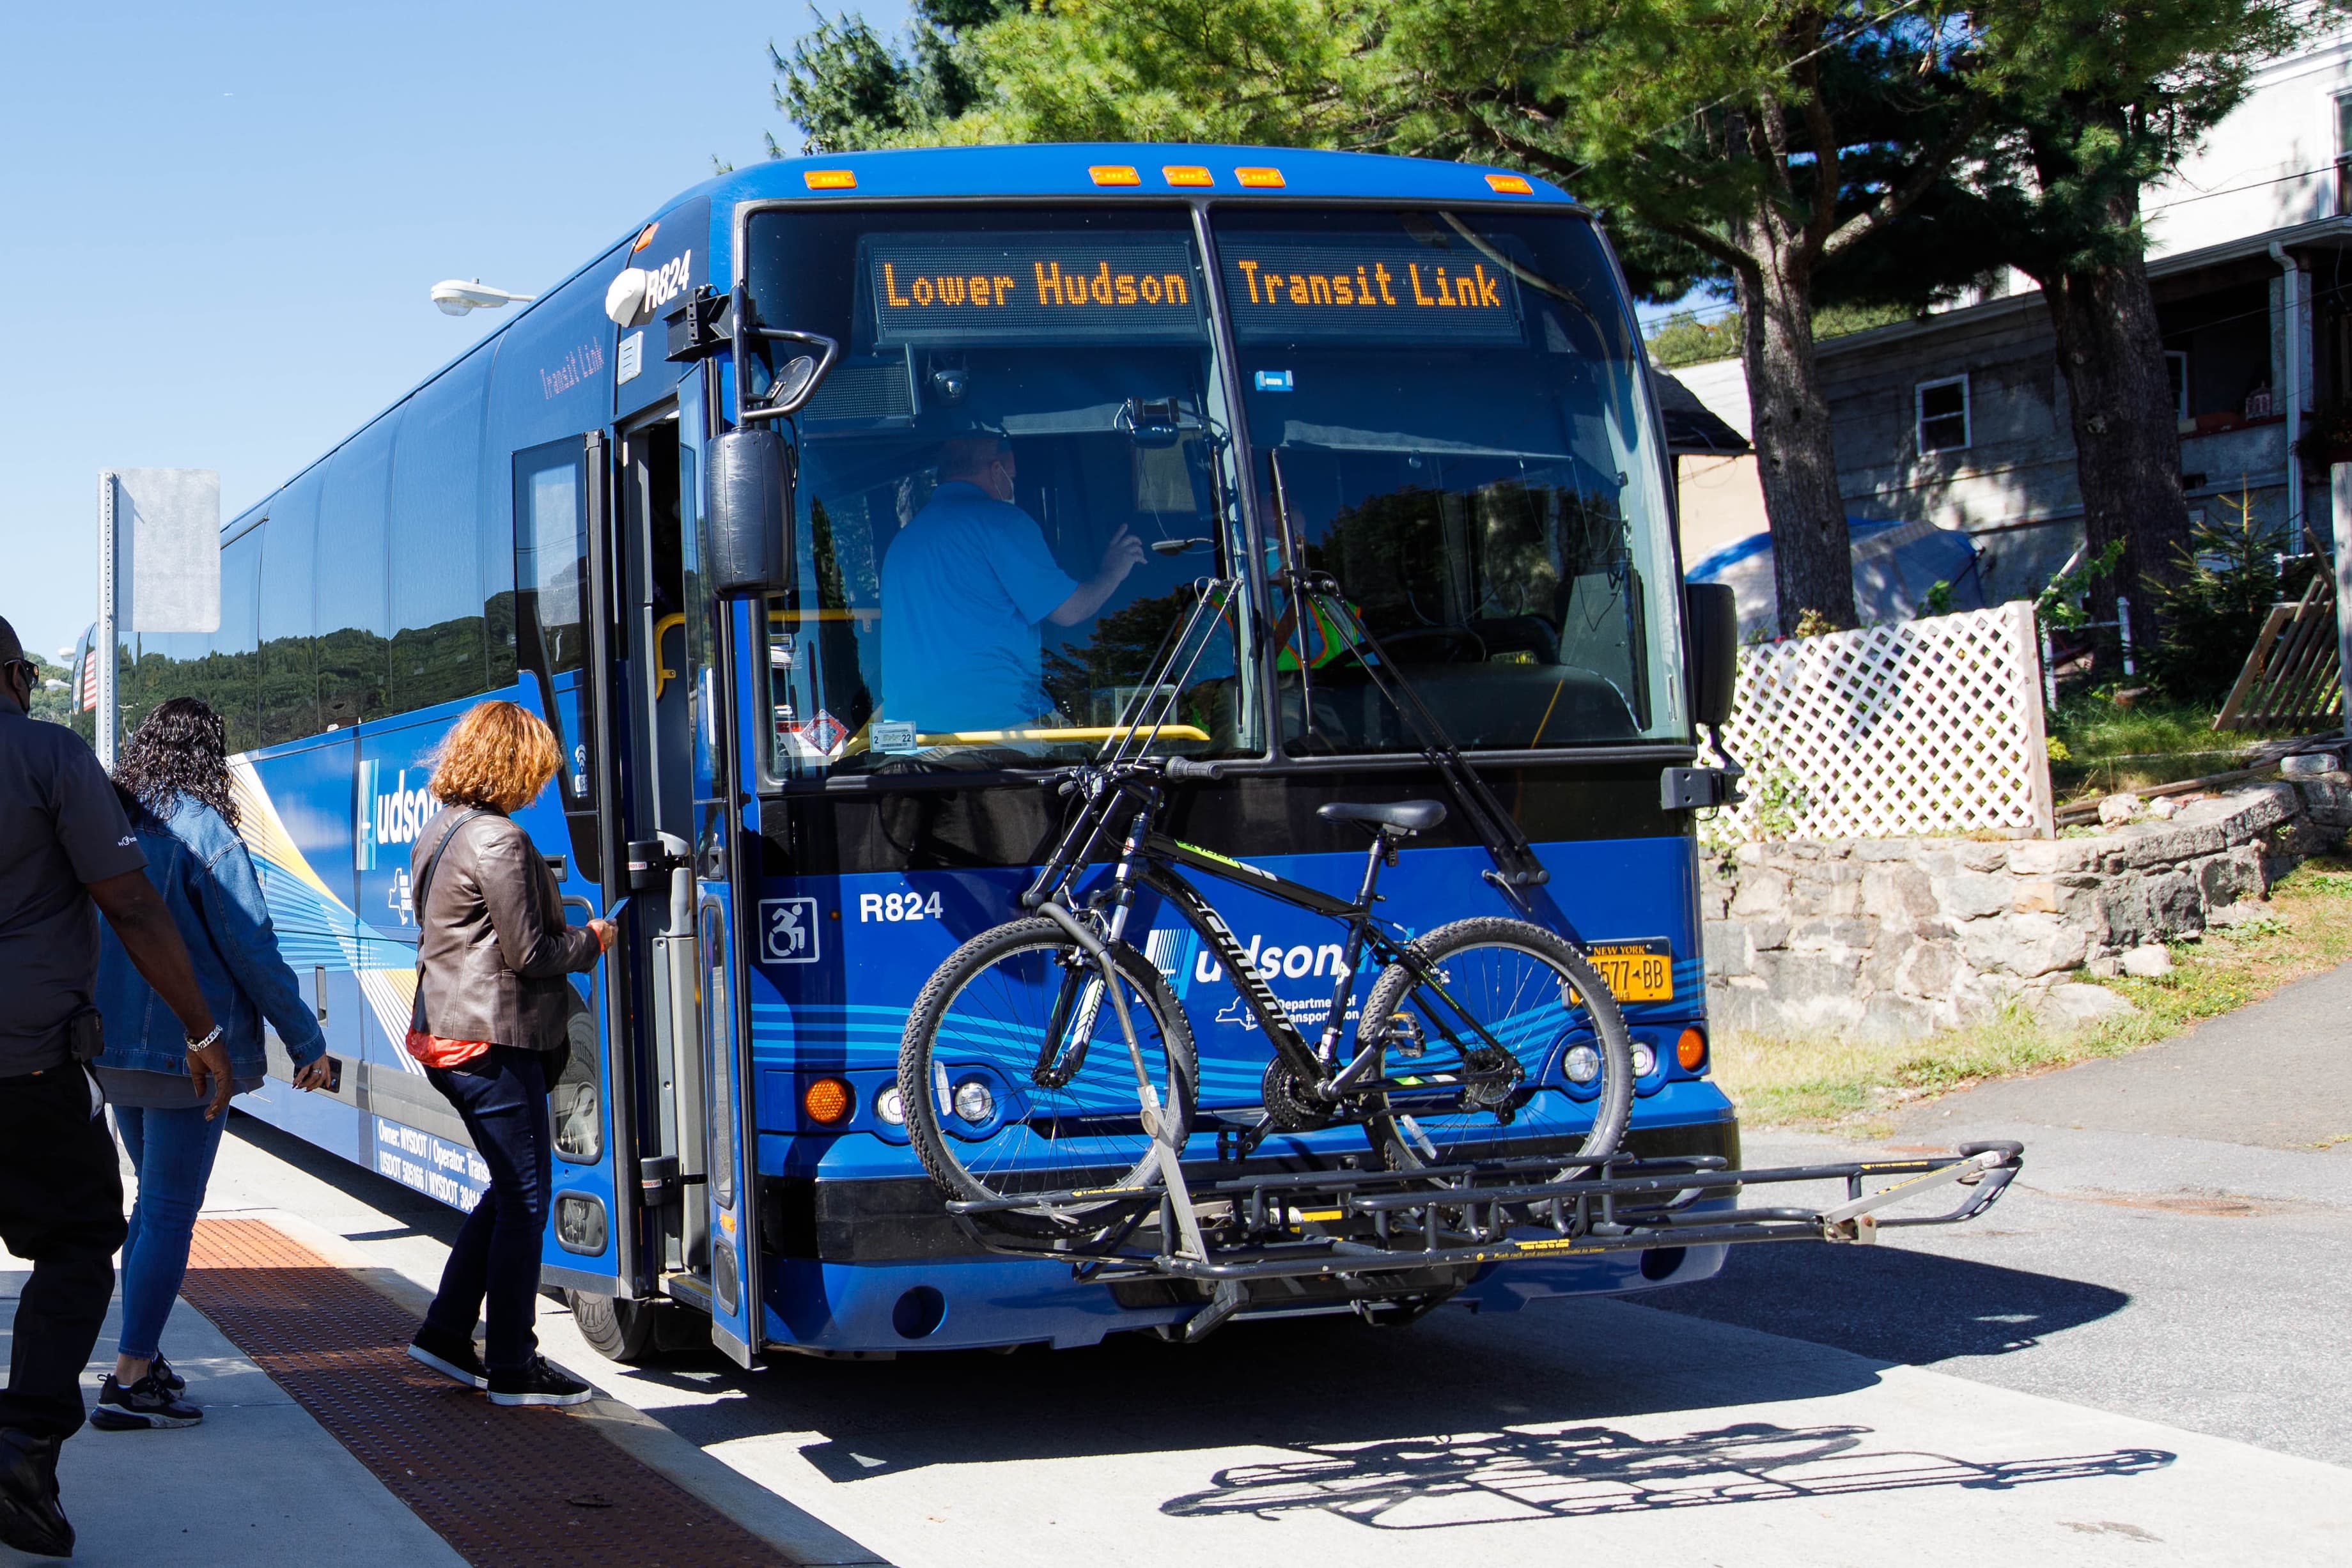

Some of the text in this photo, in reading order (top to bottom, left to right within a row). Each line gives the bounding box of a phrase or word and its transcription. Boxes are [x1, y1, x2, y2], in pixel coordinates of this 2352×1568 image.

[644, 249, 691, 313] R824
[884, 261, 1188, 307] Lower Hudson
[1238, 260, 1502, 307] Transit Link
[539, 337, 604, 400] Transit Link
[874, 734, 912, 744] 2 22
[860, 891, 944, 922] R824
[1594, 945, 1646, 956] NEW YORK
[400, 1127, 427, 1158] NYSDOT
[379, 1150, 401, 1179] USDOT
[402, 1160, 424, 1190] 505166
[429, 1170, 458, 1206] NYSDOT
